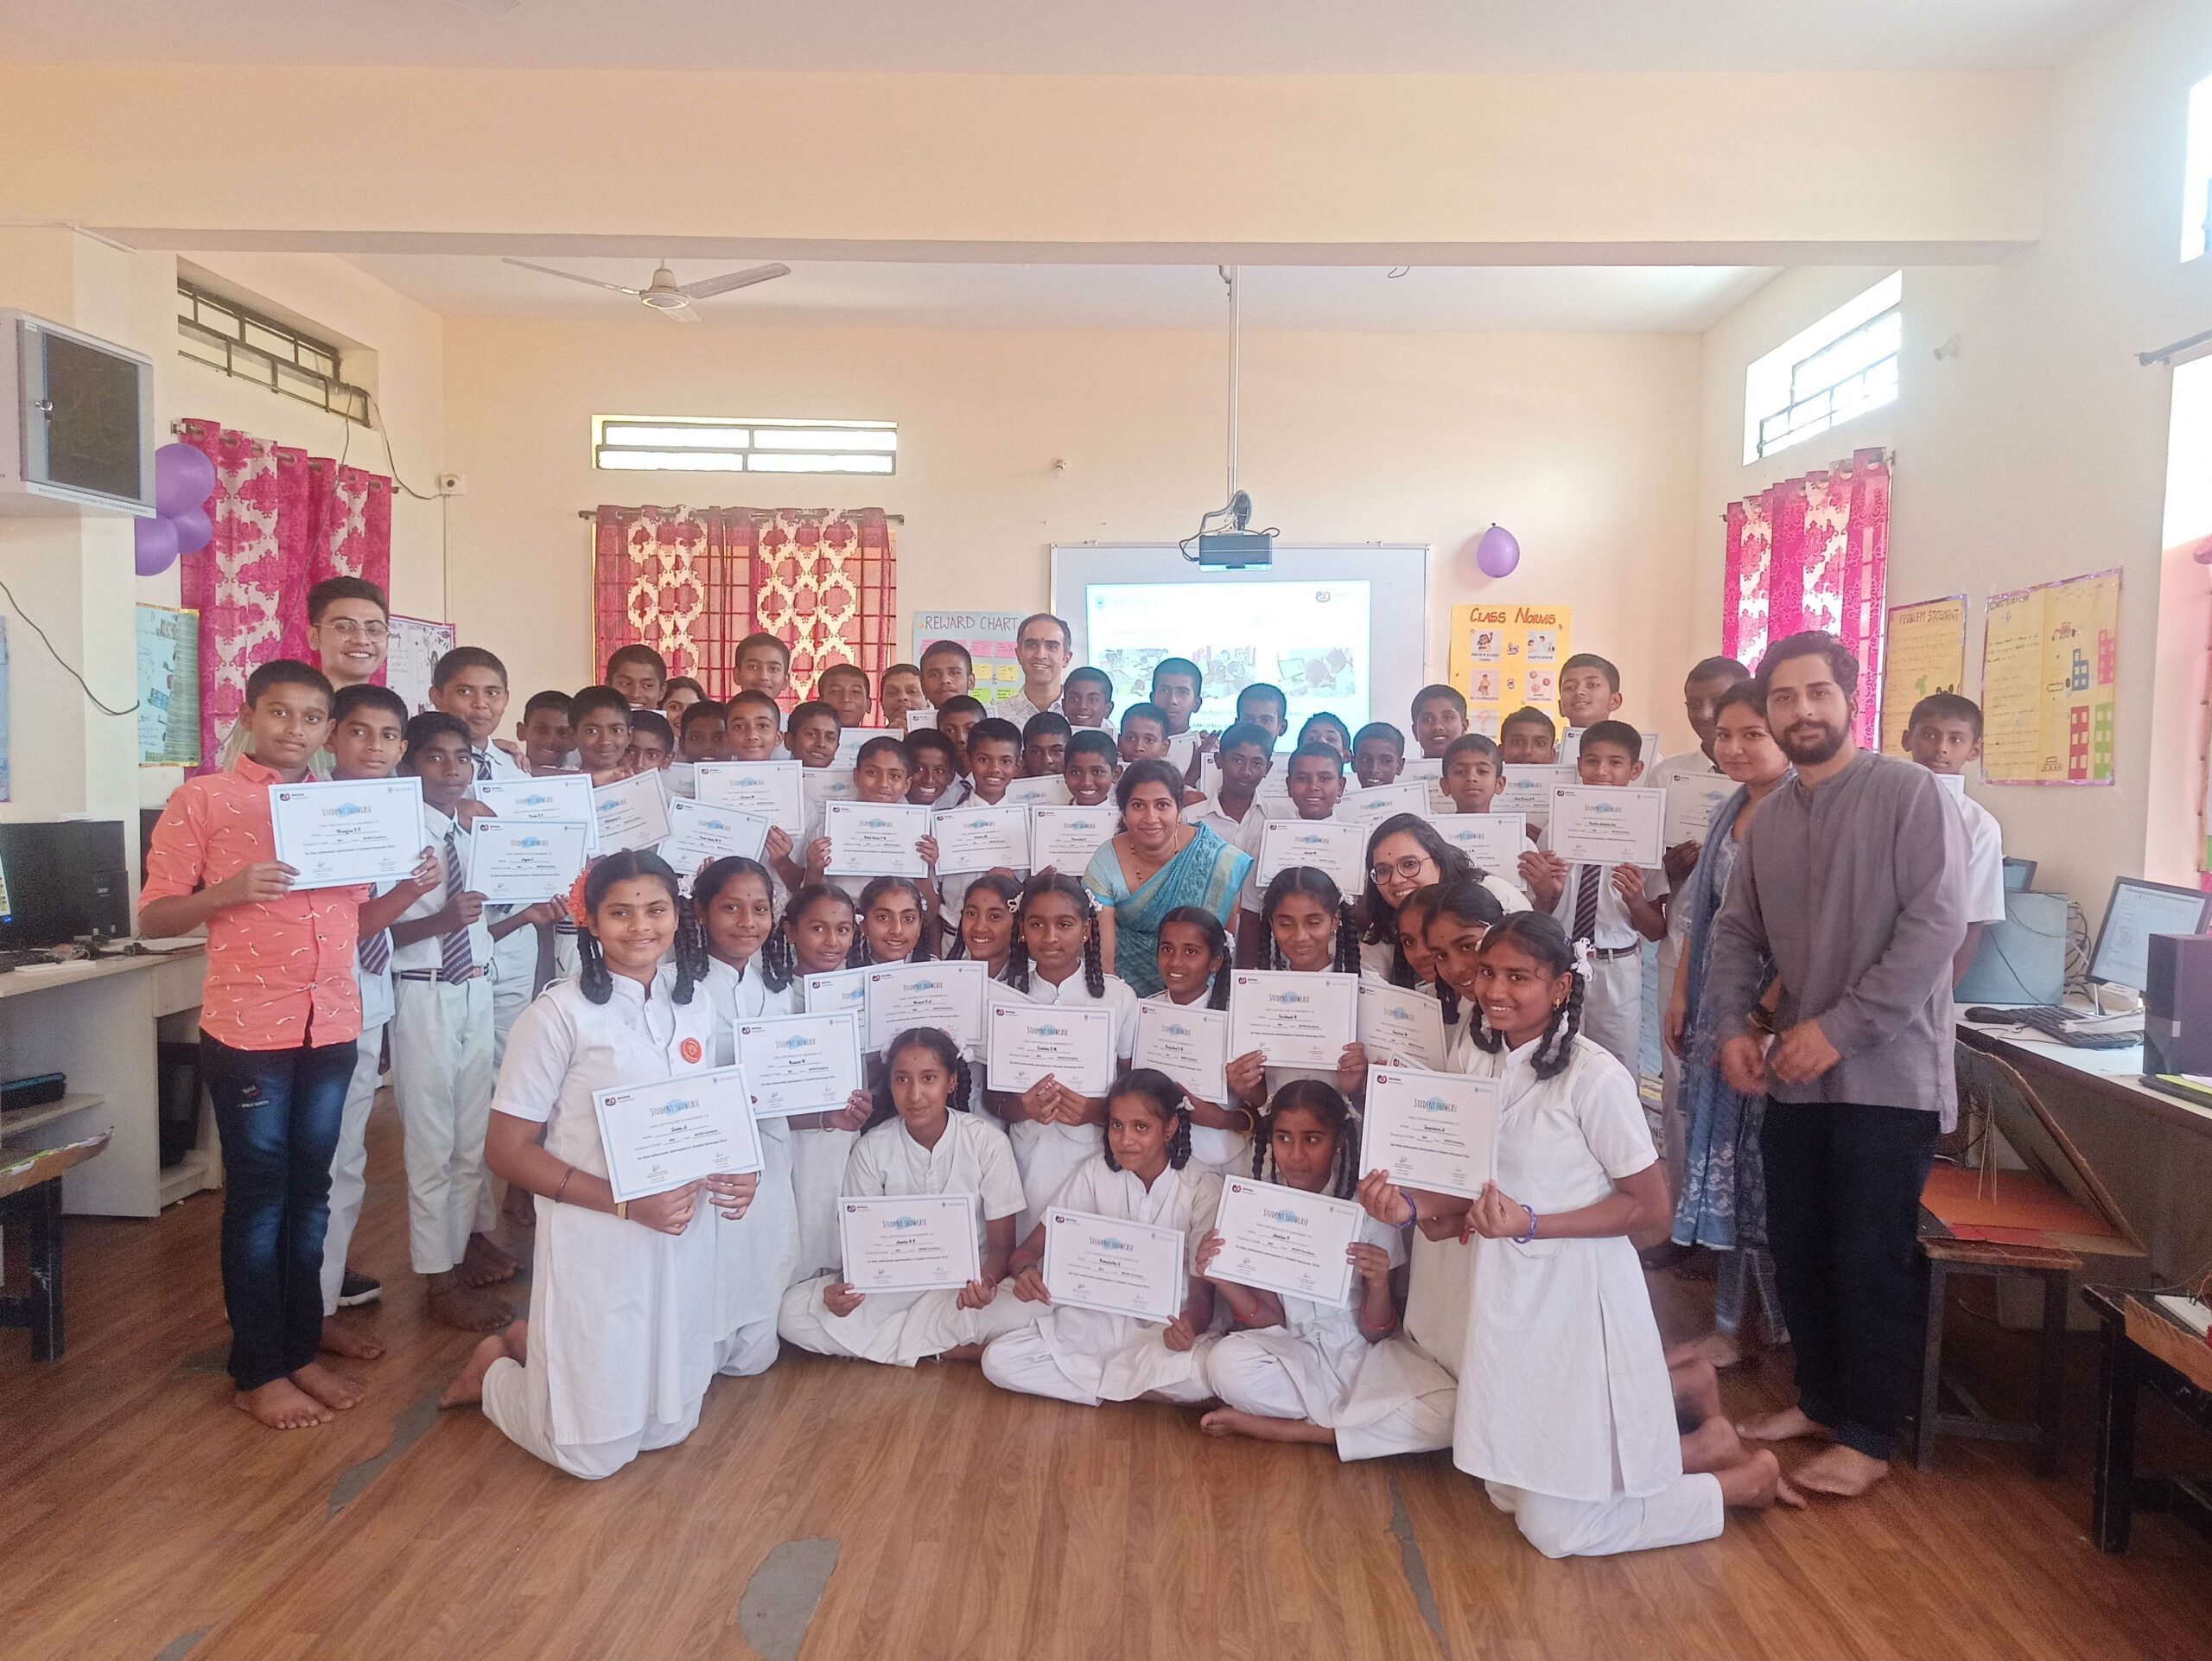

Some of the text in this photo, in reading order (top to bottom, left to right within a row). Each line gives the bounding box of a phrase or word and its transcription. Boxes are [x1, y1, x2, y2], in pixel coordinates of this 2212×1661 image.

[925, 616, 1018, 631] REWARD CHART
[1899, 608, 1959, 625] PROBLEM STATEMENT
[322, 805, 372, 817] STUDENT SHOWCASE
[1269, 994, 1287, 1002] STUDENT
[650, 1099, 699, 1117] STUDENT SHOWCASE
[1263, 1208, 1309, 1226] STUDENT SHOWCASE
